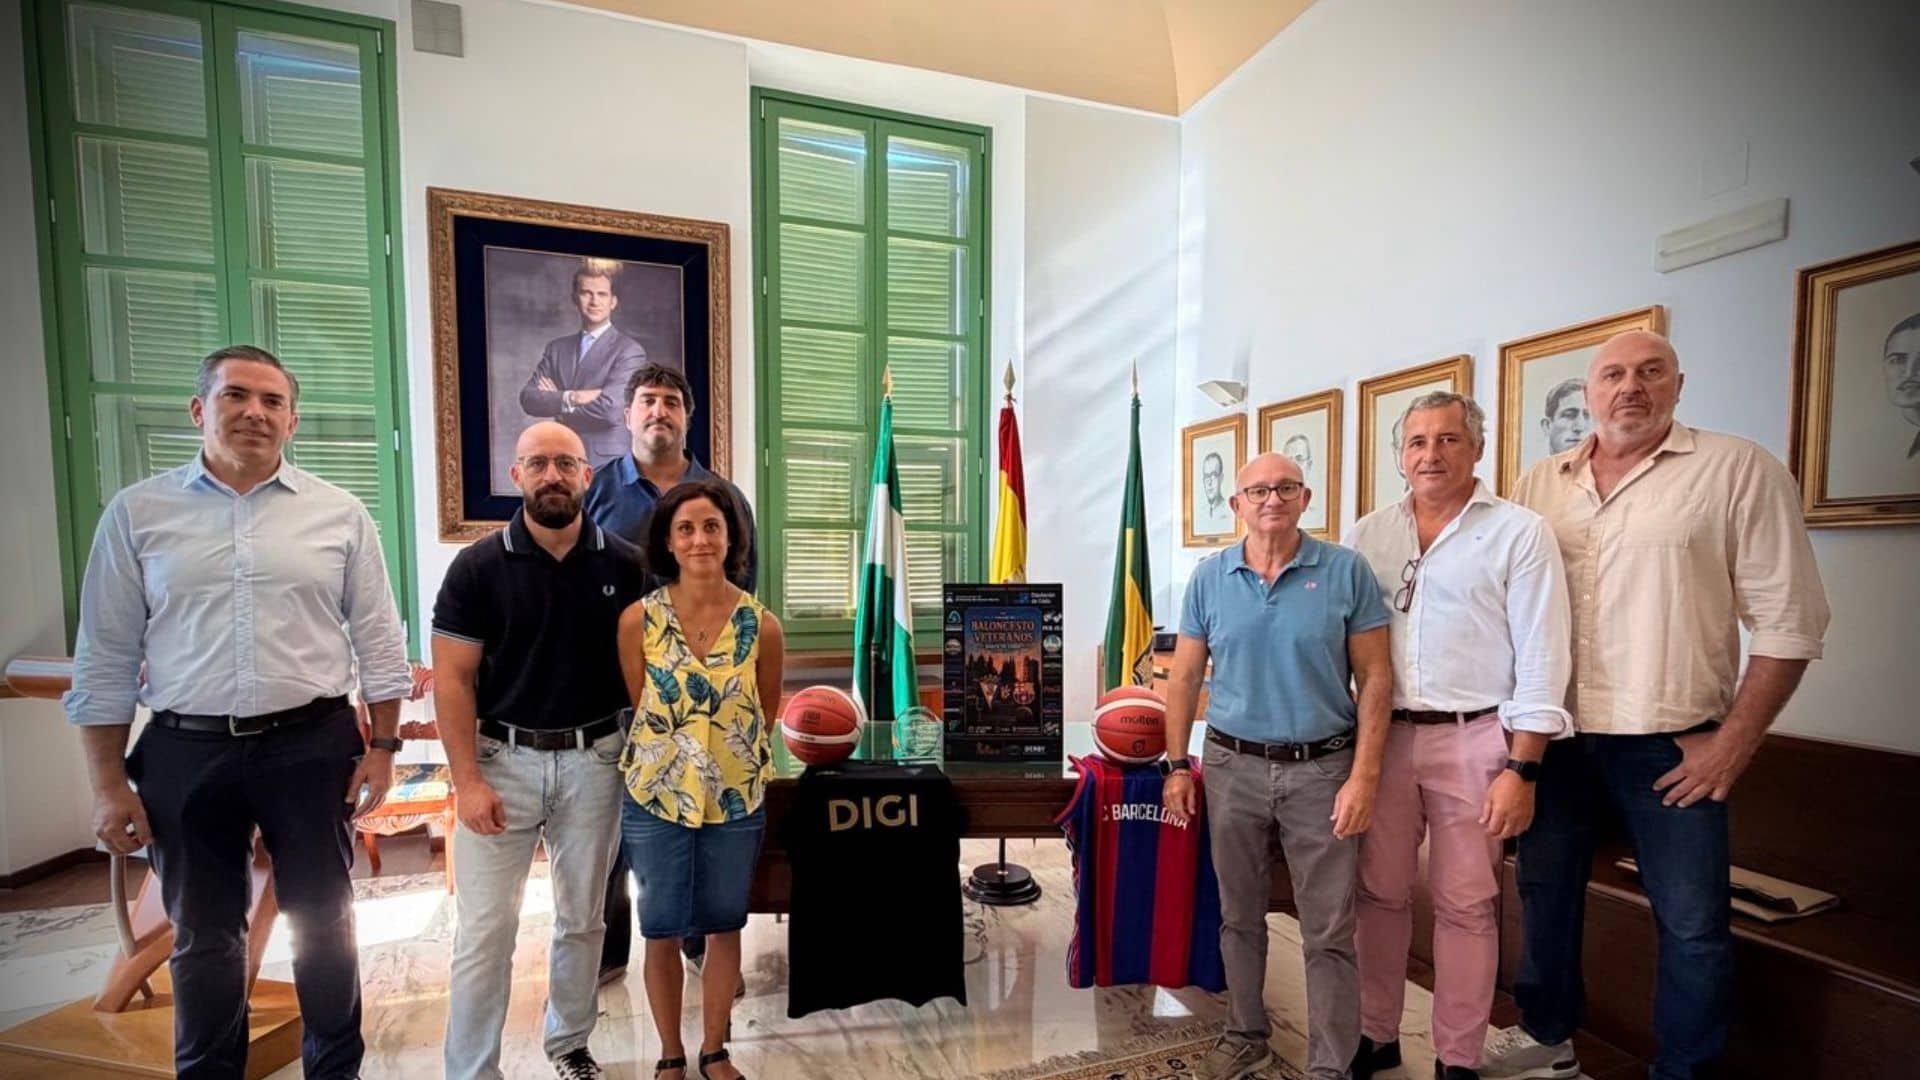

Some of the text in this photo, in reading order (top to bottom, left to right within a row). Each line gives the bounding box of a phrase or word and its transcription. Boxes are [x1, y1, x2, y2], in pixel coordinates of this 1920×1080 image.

[971, 621, 1035, 631] BALONCESTO
[974, 632, 1033, 642] VETERANOS
[1120, 715, 1159, 725] molten
[828, 794, 919, 832] DIGI
[1112, 803, 1188, 830] BARCELONA
